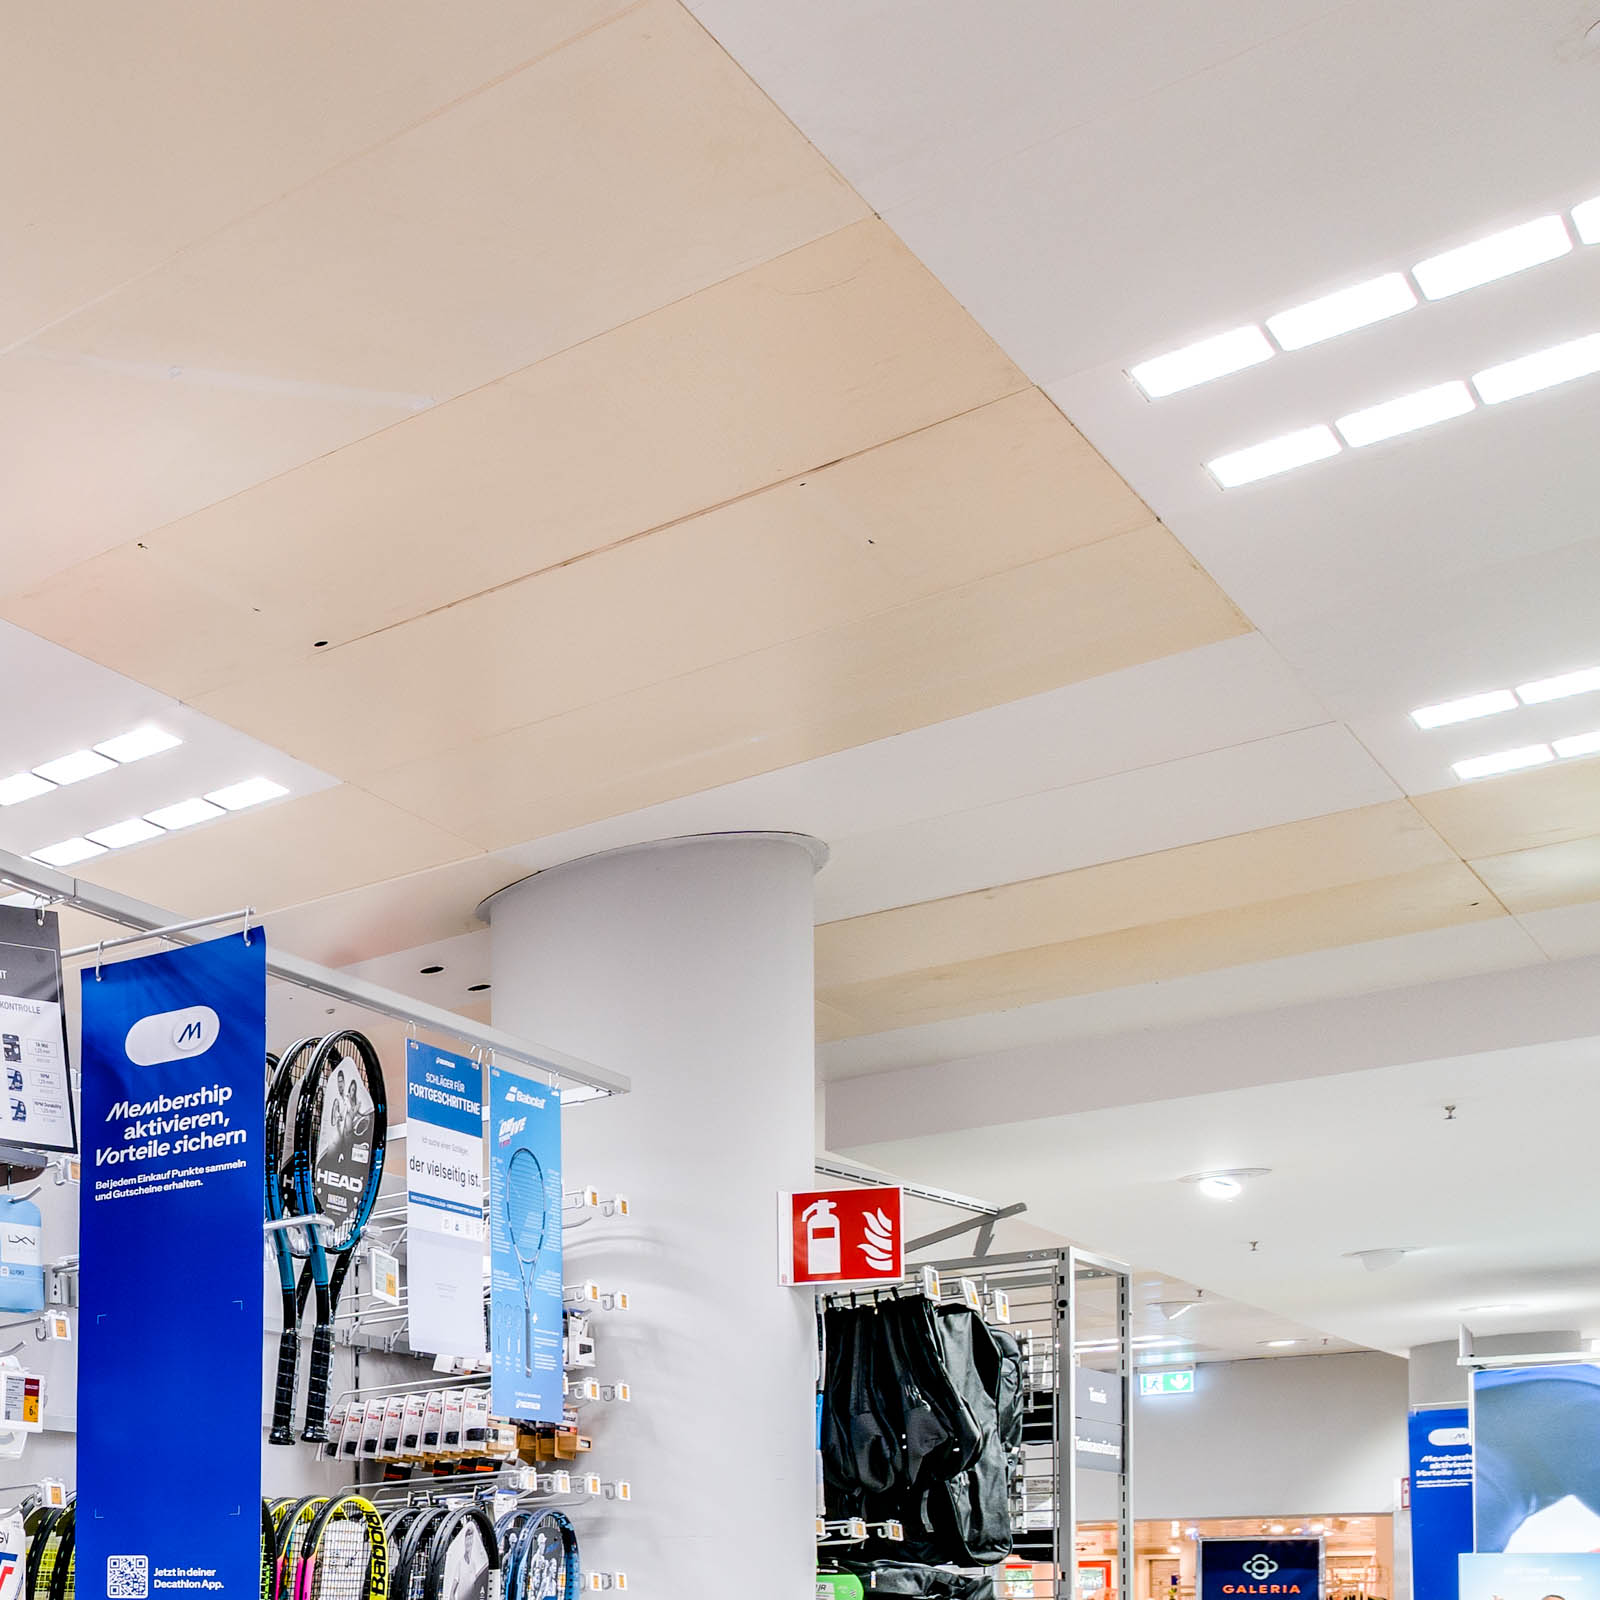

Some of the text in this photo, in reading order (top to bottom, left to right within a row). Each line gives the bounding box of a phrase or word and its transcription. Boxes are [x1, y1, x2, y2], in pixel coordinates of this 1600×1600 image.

[0, 1000, 41, 1015] KONTROLLE
[426, 1072, 465, 1093] SCHLÄGER FÜR
[105, 1084, 233, 1122] Membership
[409, 1082, 481, 1116] FORTGESCHRITTENE
[123, 1110, 230, 1141] aktivieren,
[95, 1129, 247, 1167] Vorteile sichern
[95, 1159, 246, 1190] Bei jedem Einkauf Punkte sammeln
[316, 1168, 363, 1193] HEAD
[409, 1155, 481, 1188] der vielseitig ist.
[95, 1178, 203, 1201] und Gutscheine erhalten.
[153, 1568, 216, 1577] Jetzt in deiner
[153, 1580, 224, 1591] Decathlon App.
[1222, 1584, 1301, 1594] GALERIA
